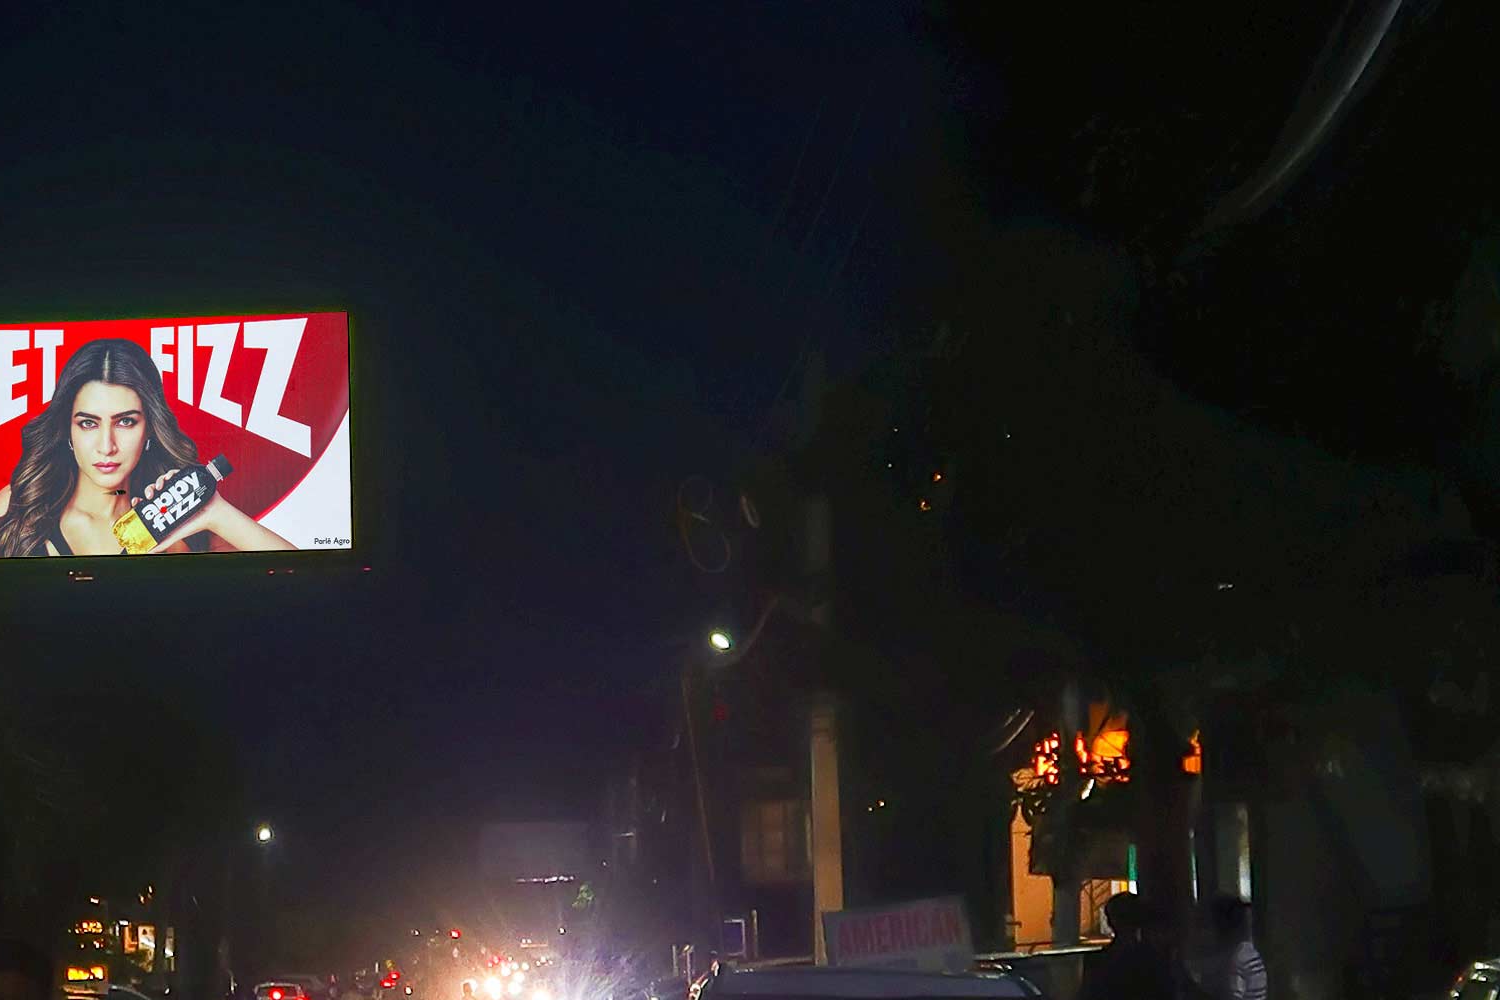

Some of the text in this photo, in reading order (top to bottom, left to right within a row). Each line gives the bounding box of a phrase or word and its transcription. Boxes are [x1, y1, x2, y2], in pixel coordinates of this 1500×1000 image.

[150, 317, 312, 458] FIZZ
[141, 471, 201, 521] appy
[152, 491, 202, 532] fizz
[333, 536, 351, 546] Agro
